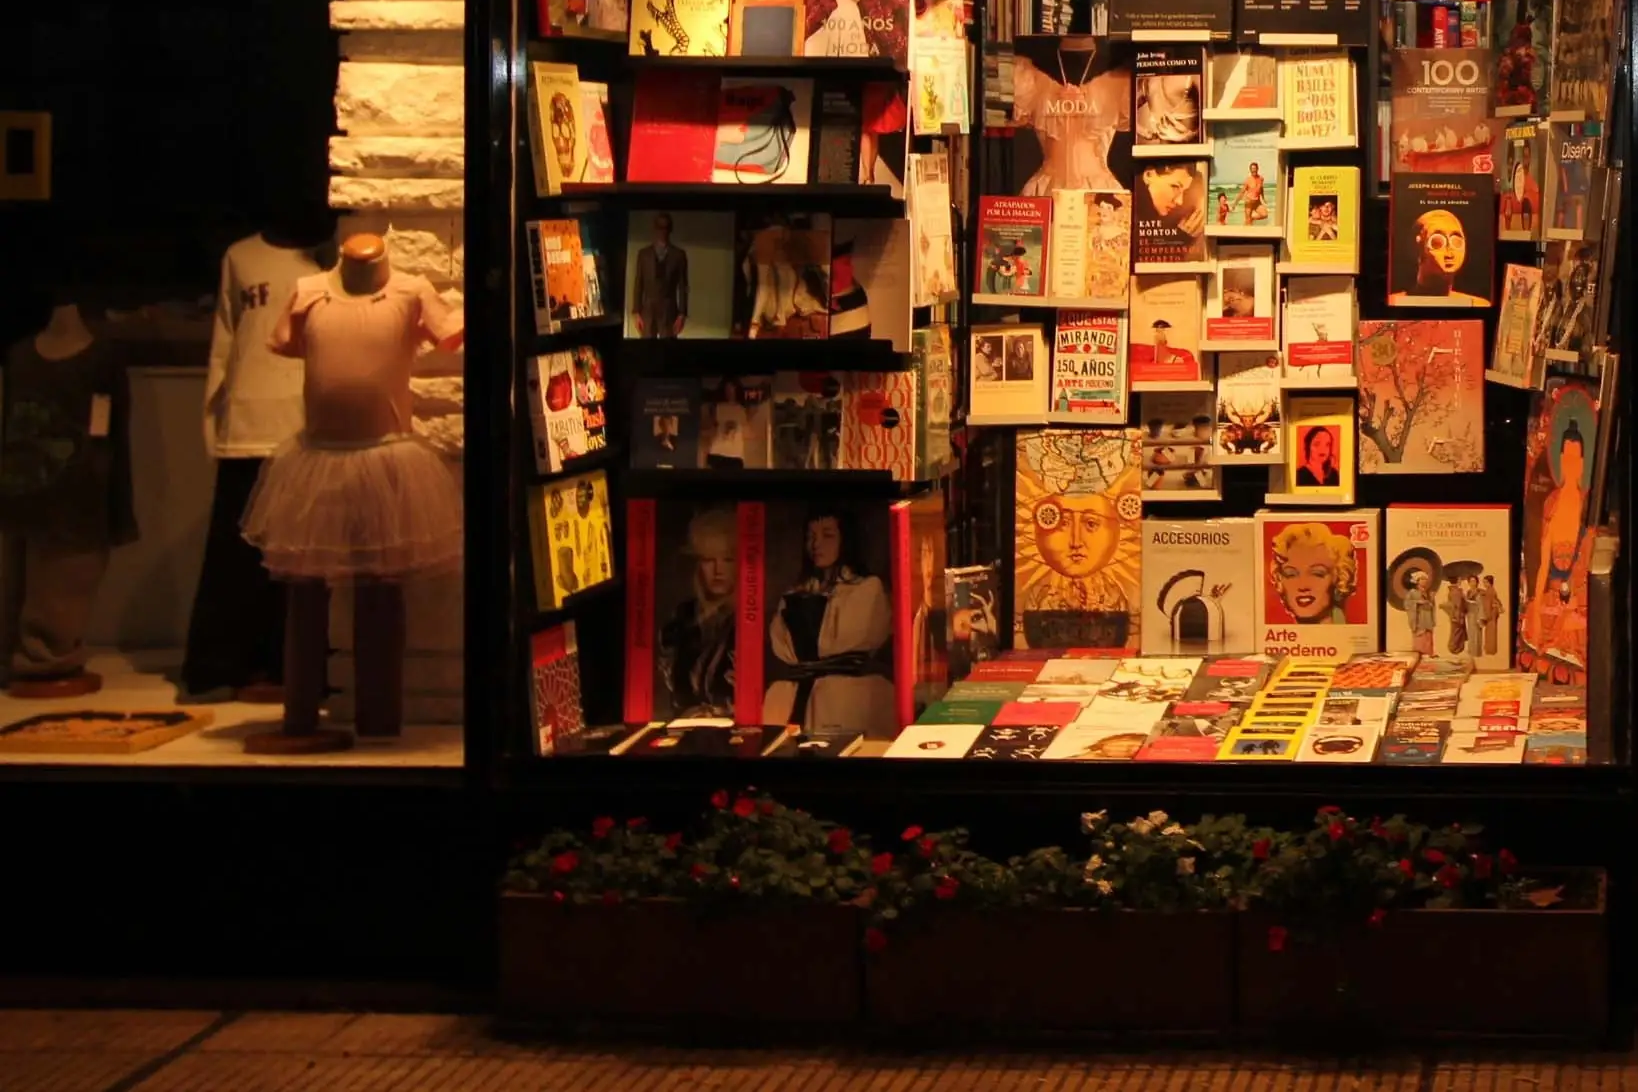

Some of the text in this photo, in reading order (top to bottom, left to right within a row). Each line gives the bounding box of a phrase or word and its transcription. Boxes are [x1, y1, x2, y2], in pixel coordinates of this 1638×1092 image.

[1420, 59, 1480, 86] 100
[1045, 99, 1100, 115] MODA
[1138, 219, 1163, 229] KATE
[1138, 228, 1178, 238] MORTON
[1059, 330, 1115, 347] MIRANDO
[1081, 357, 1115, 377] AÑOS
[1056, 379, 1084, 390] ARTE
[1151, 531, 1231, 546] ACCESORIOS
[1264, 628, 1297, 642] Arte
[1264, 643, 1338, 657] moderno
